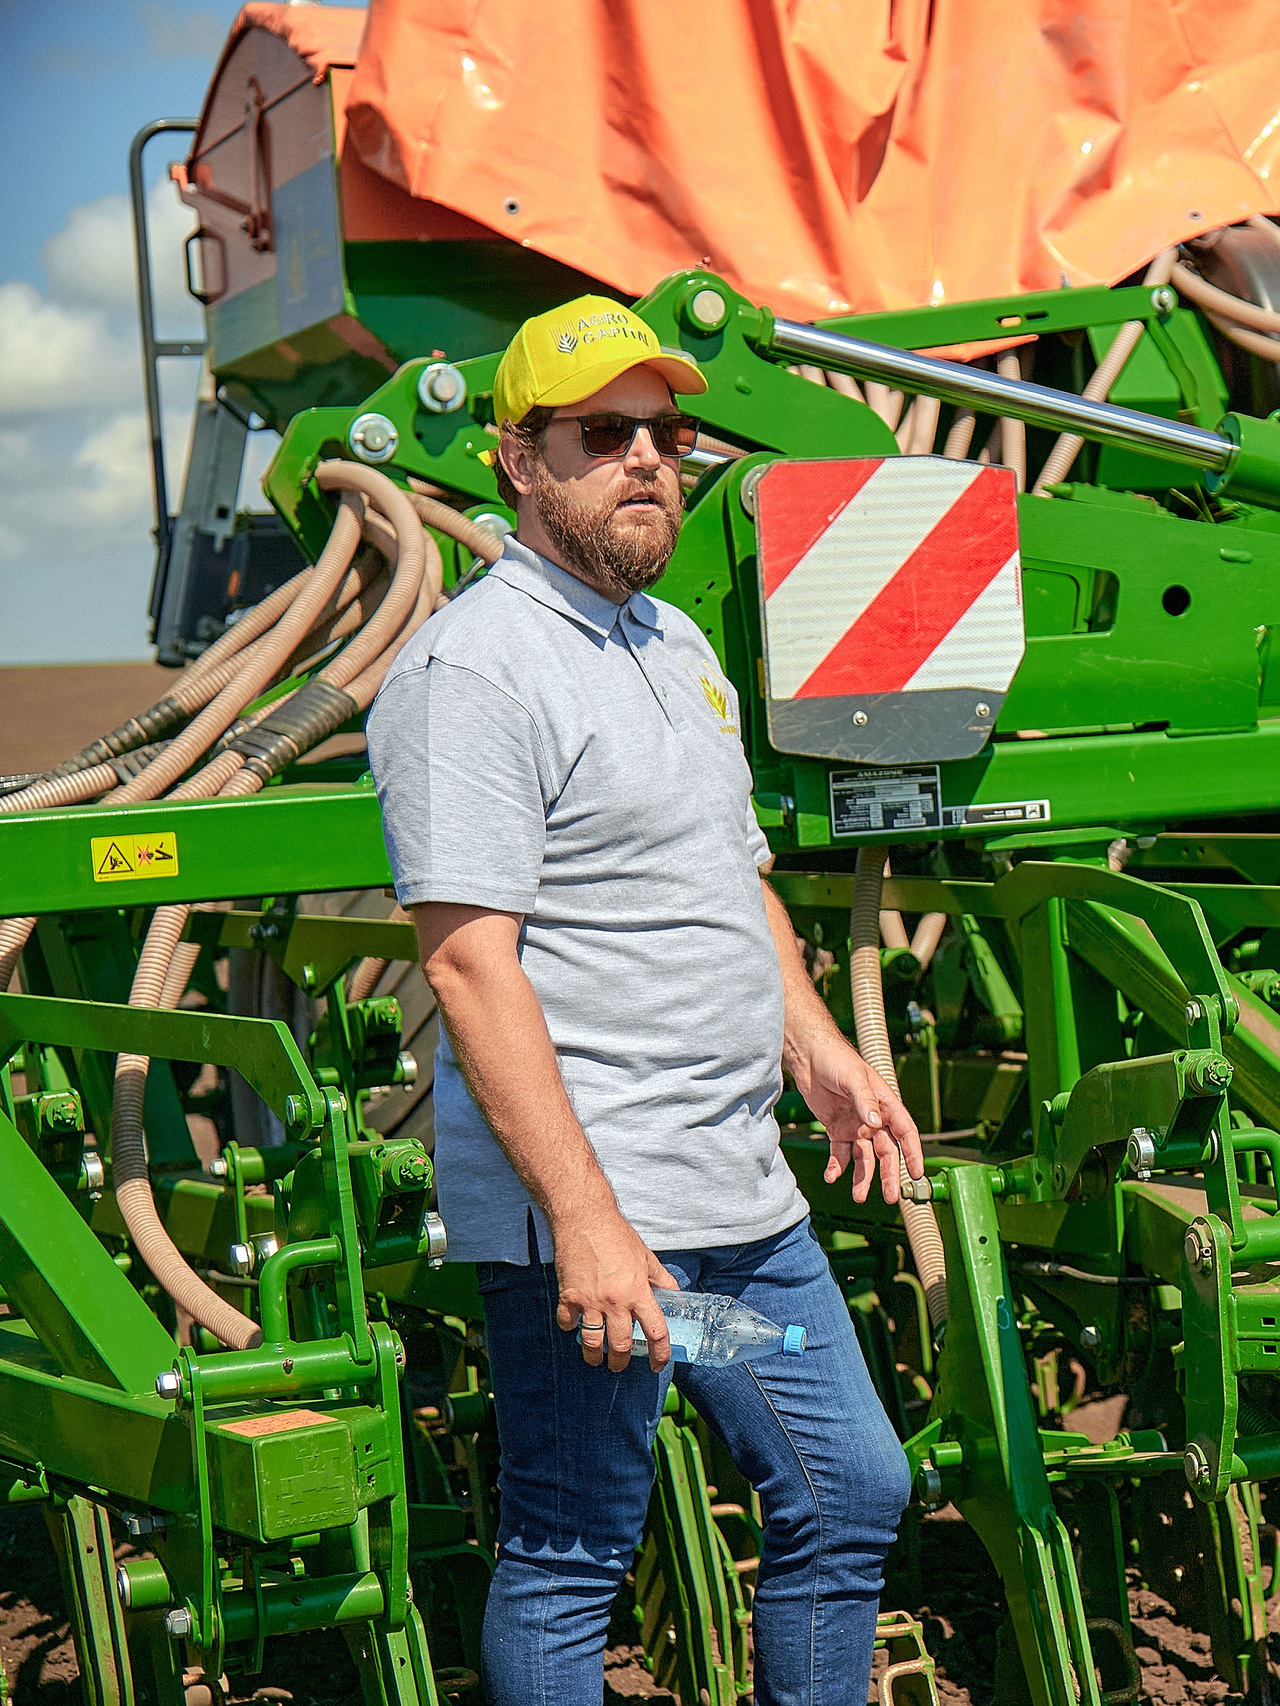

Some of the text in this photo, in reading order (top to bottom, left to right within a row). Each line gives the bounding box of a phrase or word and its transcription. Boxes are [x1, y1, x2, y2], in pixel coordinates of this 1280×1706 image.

[578, 312, 628, 331] AGRO
[857, 769, 903, 777] AMAZONE
[274, 1507, 351, 1530] AMAZONE
